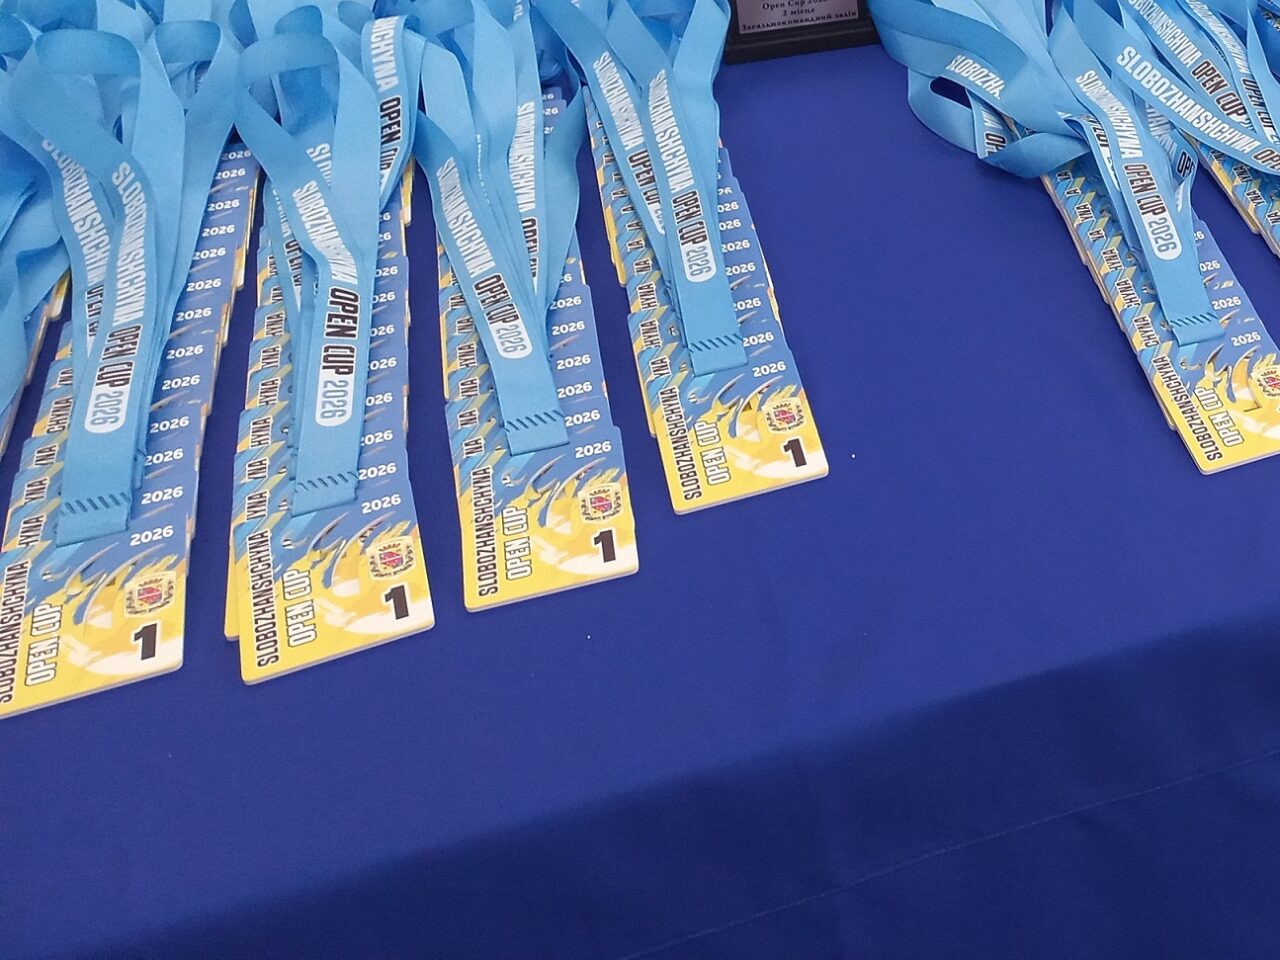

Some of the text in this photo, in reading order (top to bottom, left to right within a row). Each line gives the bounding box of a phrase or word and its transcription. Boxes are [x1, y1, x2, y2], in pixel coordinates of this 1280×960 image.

[762, 2, 785, 11] Open
[788, 0, 806, 8] Cup
[1117, 46, 1261, 154] SLOBOZHANSHCHYNA
[1191, 60, 1230, 95] OPEN
[1215, 92, 1248, 123] CUP
[379, 95, 402, 145] OPEN
[215, 168, 246, 180] 2026
[1123, 163, 1157, 195] OPEN
[207, 199, 240, 211] 2026
[1136, 193, 1167, 216] CUP
[202, 225, 235, 237] 2026
[671, 189, 712, 277] OPEN CUP 2026
[719, 219, 741, 230] 026
[1149, 217, 1177, 253] 2026
[192, 247, 226, 260] 2026
[725, 262, 756, 276] 2026
[1199, 260, 1221, 272] 026
[187, 279, 221, 292] 2026
[550, 296, 582, 310] 2026
[1212, 296, 1242, 310] 2026
[176, 308, 212, 321] 2026
[474, 272, 527, 353] OPEN CUP 2026
[552, 320, 585, 335] 2026
[742, 332, 774, 347] 2026
[1231, 332, 1261, 346] 2026
[166, 345, 204, 360] 2026
[320, 286, 360, 420] OPEN CUP 2026
[556, 354, 591, 370] 2026
[752, 361, 786, 378] 2026
[91, 324, 142, 426] OPEN CUP 2026
[161, 375, 200, 390] 2026
[557, 381, 592, 398] 2026
[365, 393, 393, 405] 026
[1152, 356, 1222, 461] SLOBOZHANSHCHYNA
[1194, 386, 1244, 447] OPEN CUP
[150, 416, 190, 433] 2026
[564, 410, 600, 427] 2026
[575, 441, 612, 458] 2026
[659, 386, 703, 501] SLOBOZHANSHCHYNA
[145, 448, 184, 465] 2026
[693, 420, 731, 486] OPEN CUP
[783, 438, 807, 468] 1
[359, 463, 396, 480] 2026
[141, 486, 183, 505] 2026
[362, 494, 401, 514] 2026
[130, 525, 174, 546] 2026
[472, 466, 498, 597] SLOBOZHANSHCHYNA
[502, 506, 532, 581] OPEN CUP
[594, 529, 616, 563] 1
[247, 529, 279, 667] SLOBOZHANSHCHYNA
[385, 585, 409, 620] 1
[282, 569, 317, 647] OPEN CUP
[25, 603, 63, 687] OPEN CUP
[133, 623, 158, 661] 1
